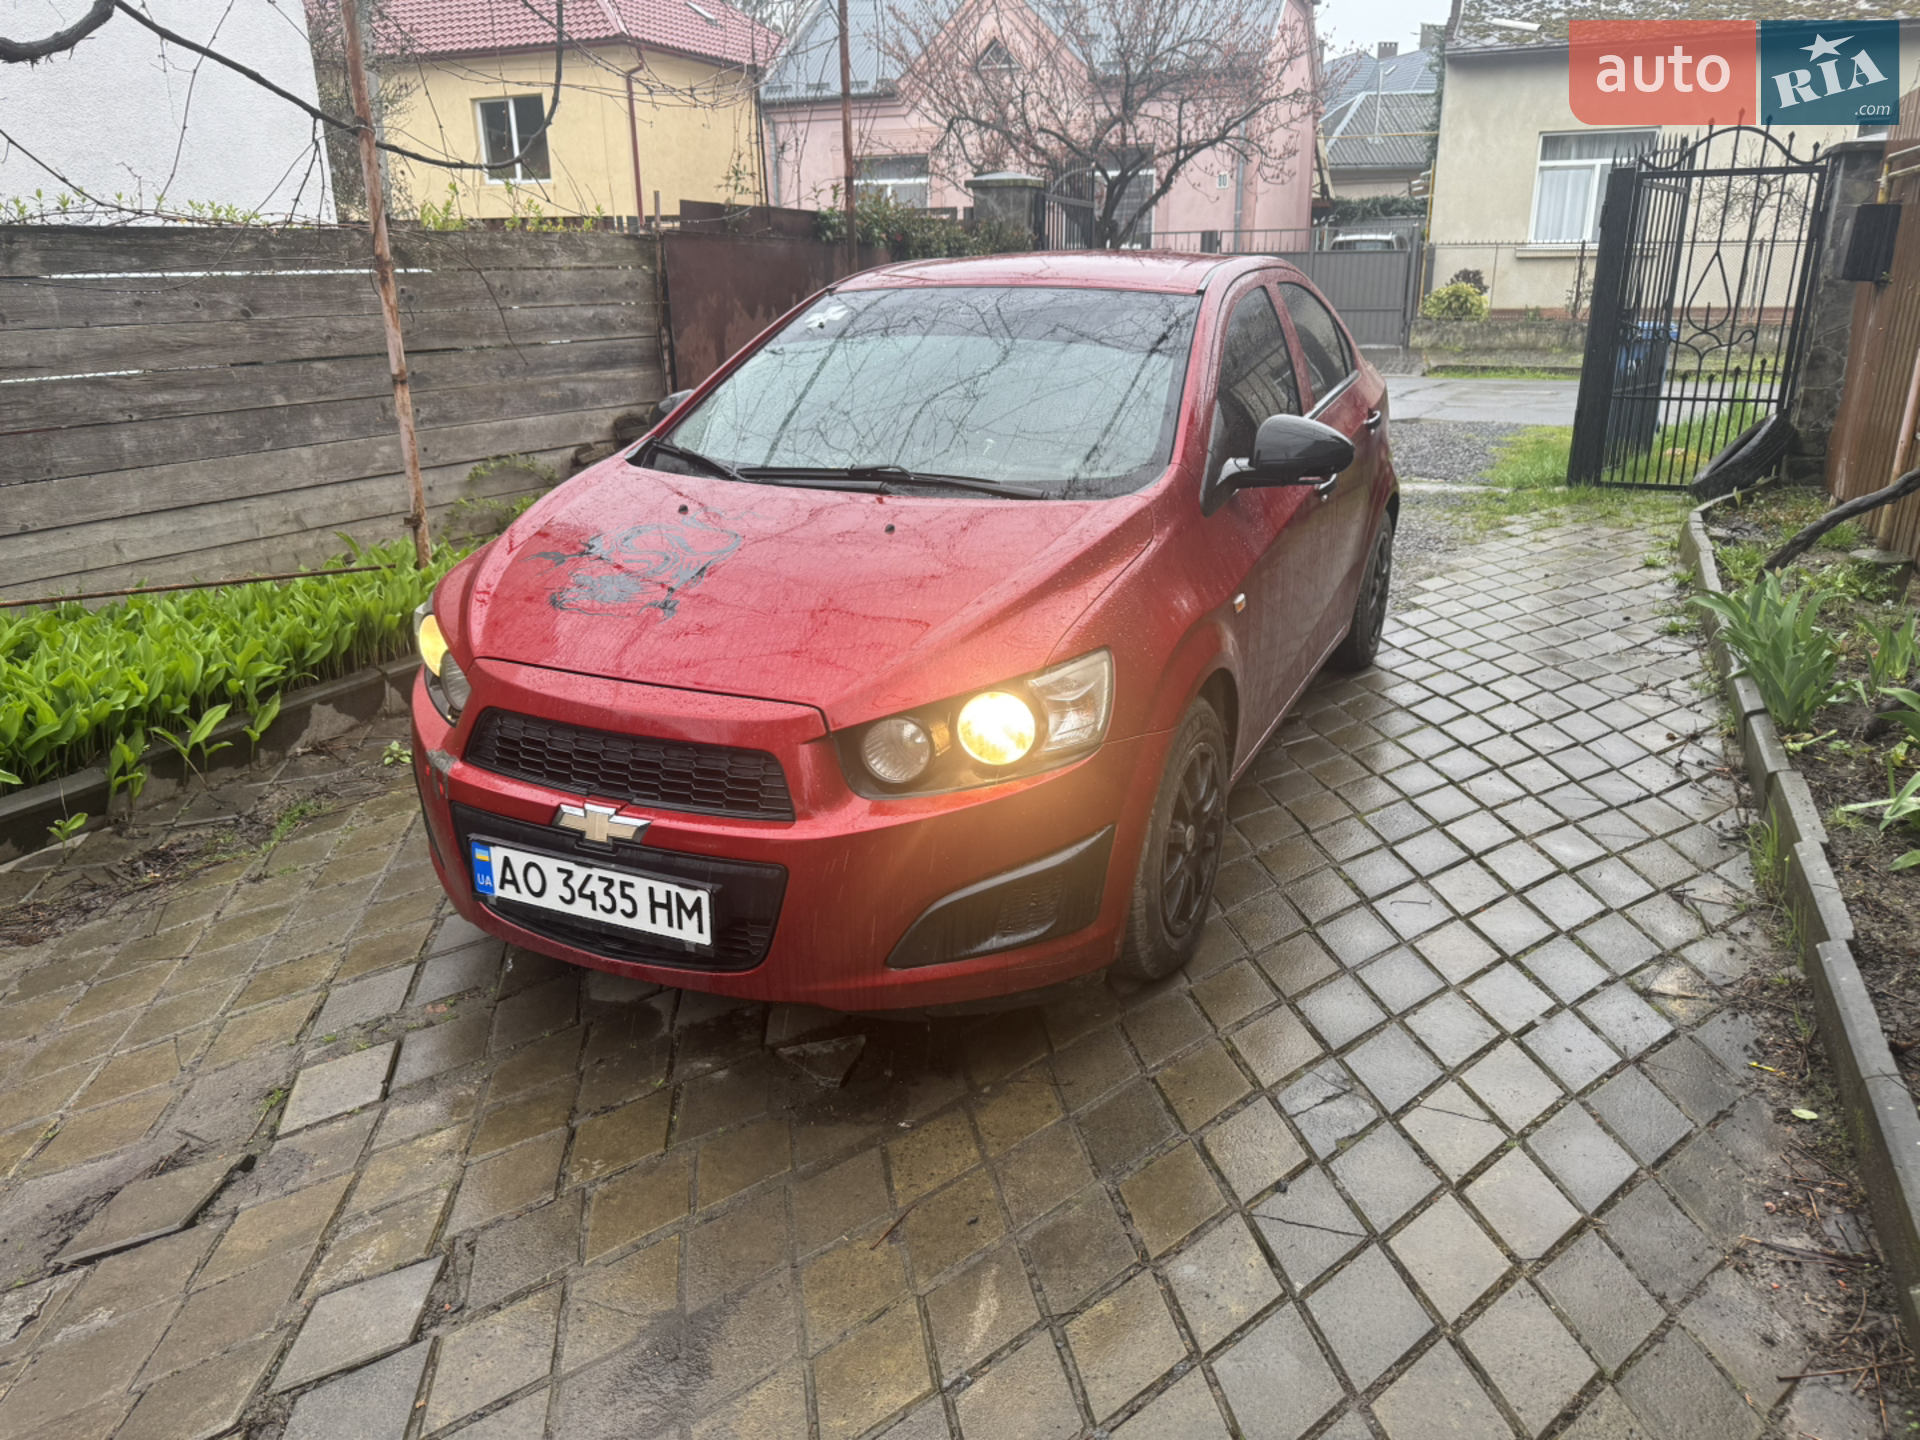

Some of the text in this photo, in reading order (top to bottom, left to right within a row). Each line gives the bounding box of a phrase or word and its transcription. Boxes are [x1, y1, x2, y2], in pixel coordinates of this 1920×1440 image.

[476, 872, 493, 887] UA
[498, 855, 704, 934] AO 3435 HM
